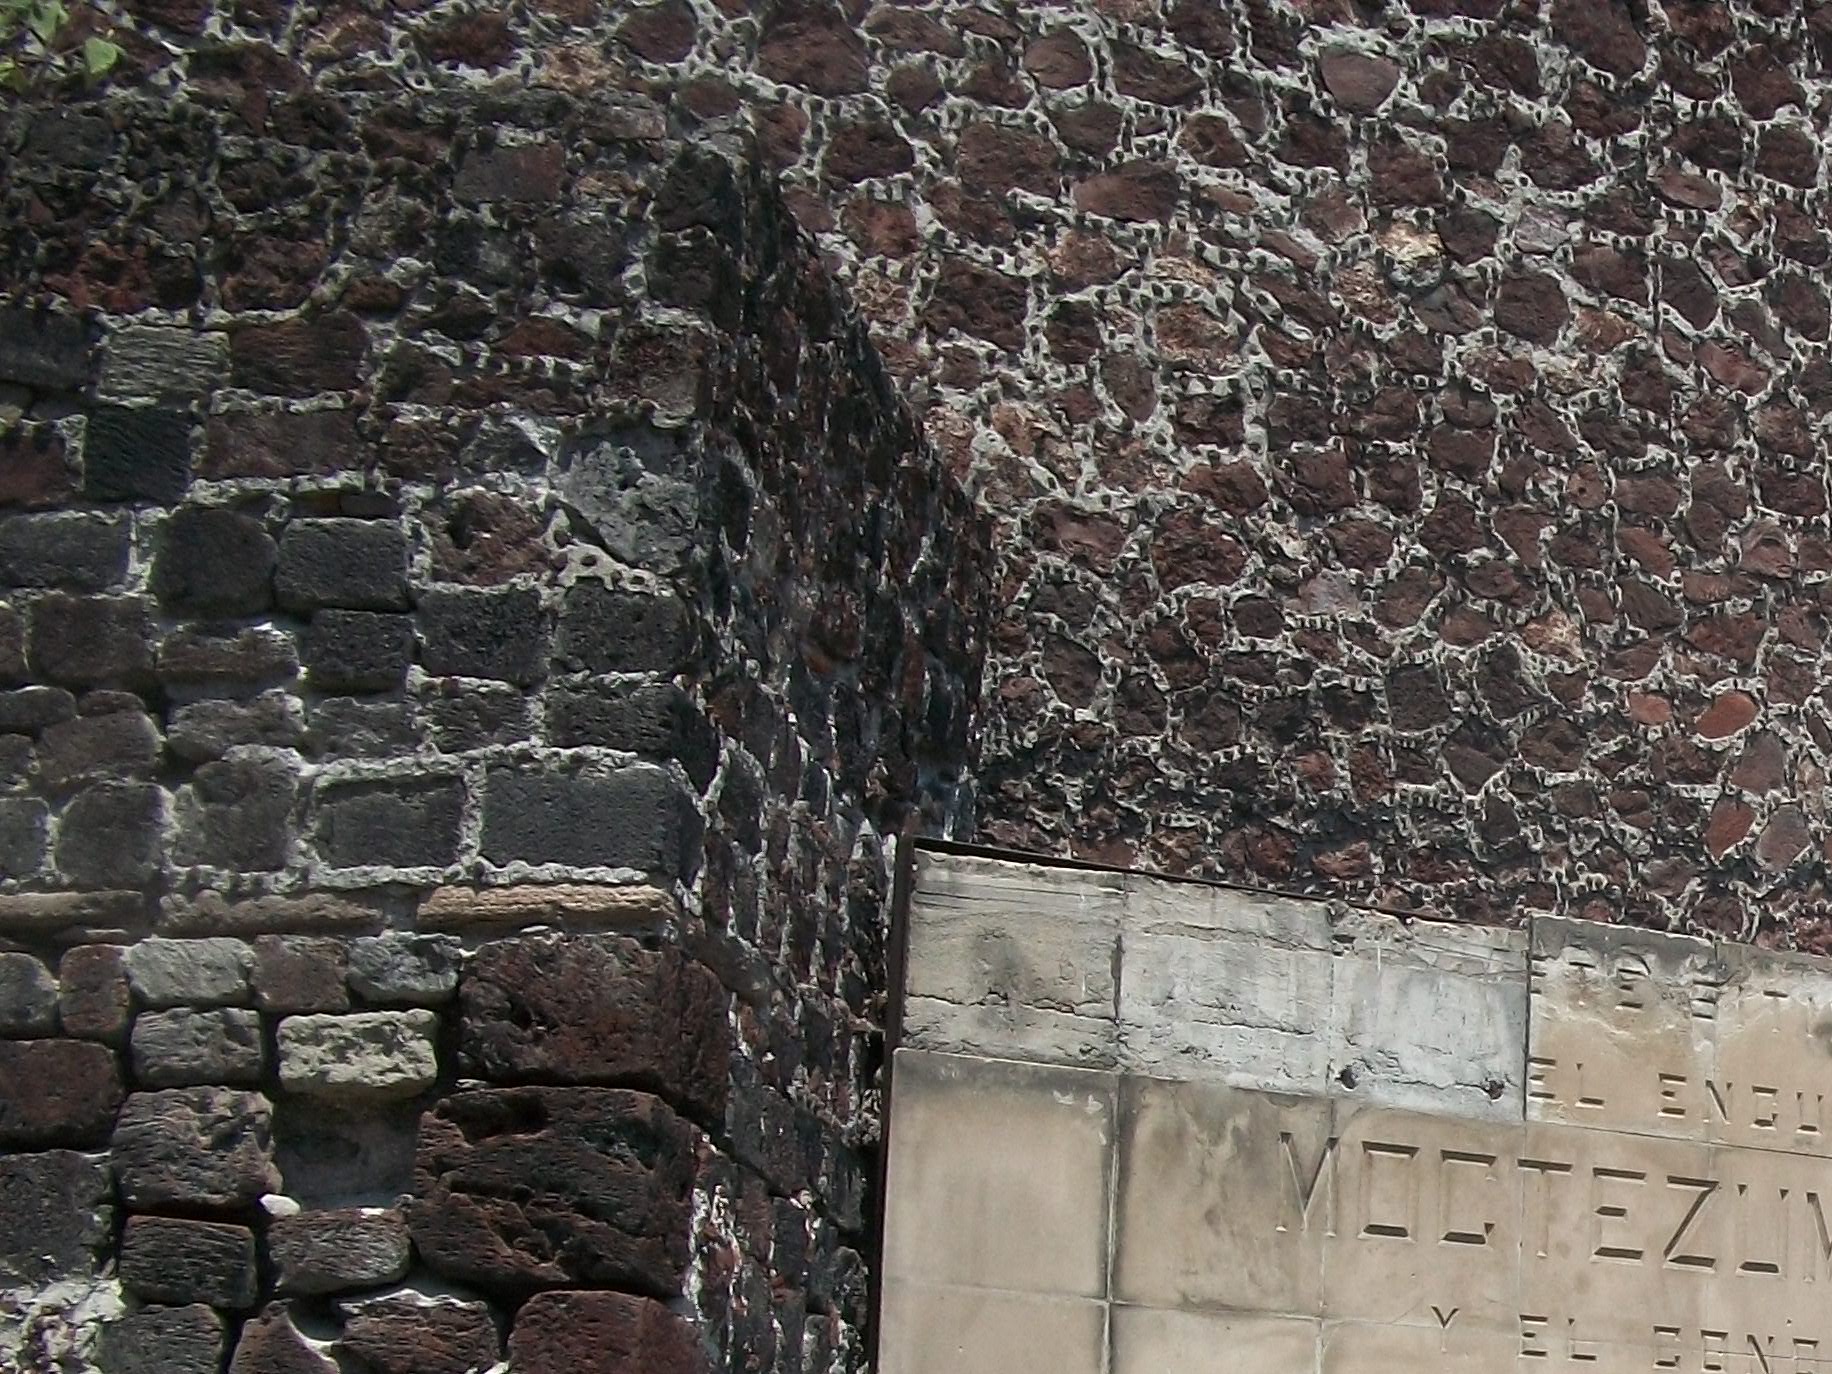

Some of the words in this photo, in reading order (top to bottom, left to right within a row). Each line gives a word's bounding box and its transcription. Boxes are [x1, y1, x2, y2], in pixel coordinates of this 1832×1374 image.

[1528, 1056, 1605, 1109] EL
[1430, 1305, 1460, 1353] Y
[1517, 1313, 1598, 1362] EL
